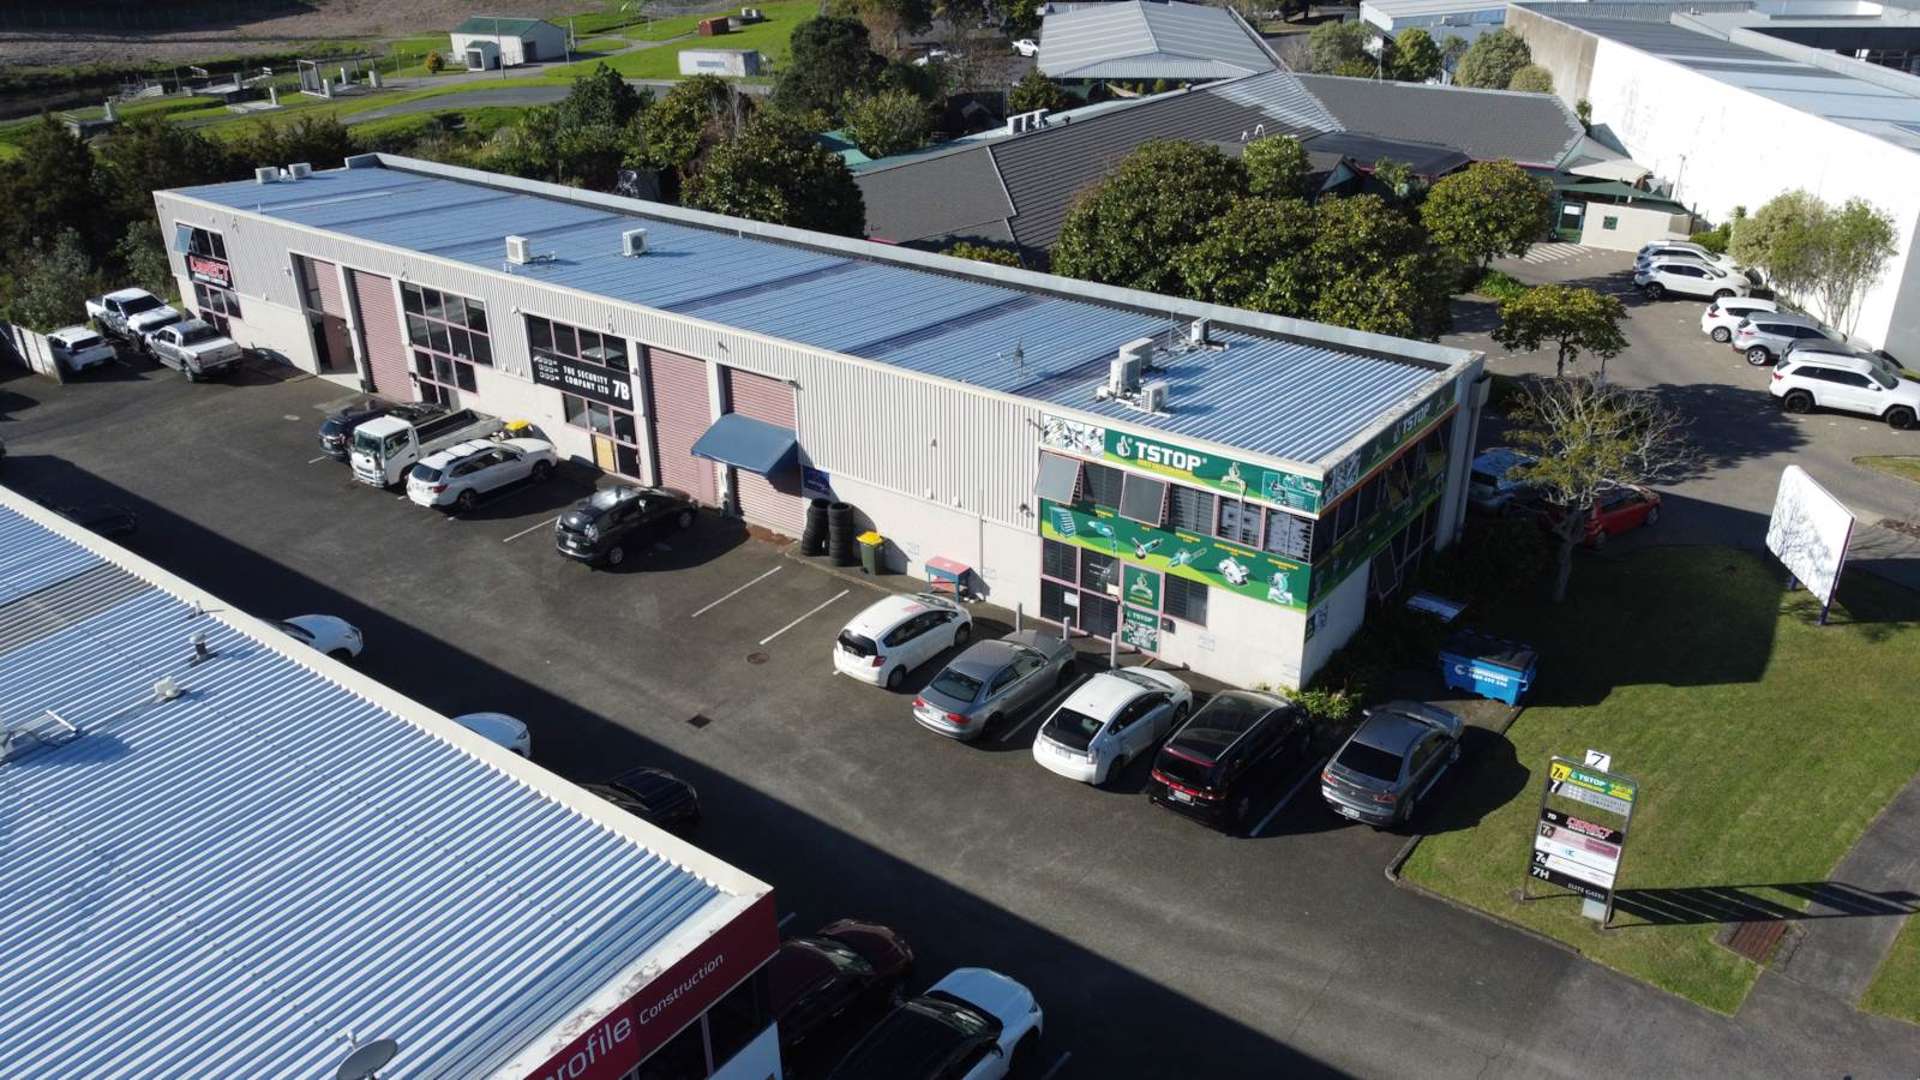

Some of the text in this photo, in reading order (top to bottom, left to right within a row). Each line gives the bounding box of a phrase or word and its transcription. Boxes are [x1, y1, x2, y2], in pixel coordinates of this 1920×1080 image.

[563, 365, 608, 385] THE SECURITY
[565, 376, 609, 395] COMPANY LTD
[612, 380, 630, 401] 7B
[1135, 441, 1201, 472] TSTOP
[1591, 752, 1605, 767] 7
[1532, 867, 1549, 880] 7H
[639, 952, 724, 1025] Construction
